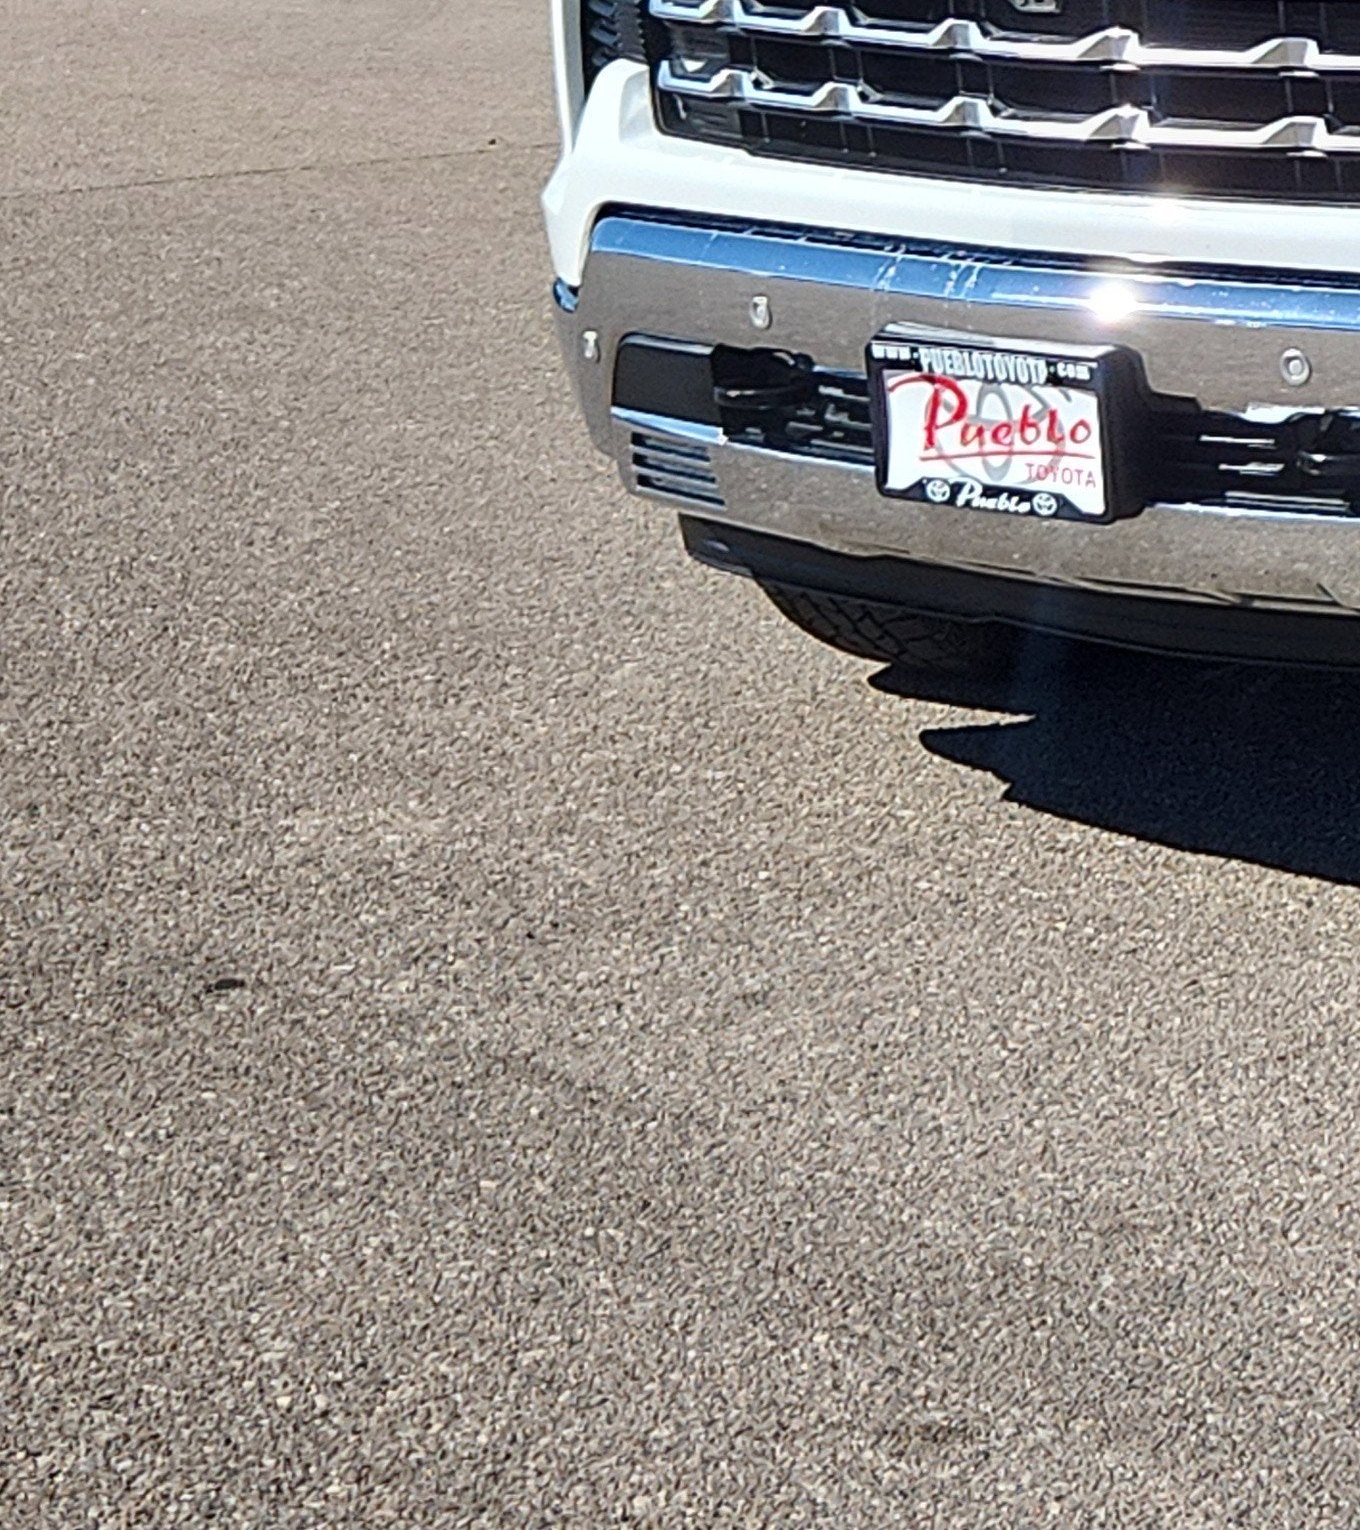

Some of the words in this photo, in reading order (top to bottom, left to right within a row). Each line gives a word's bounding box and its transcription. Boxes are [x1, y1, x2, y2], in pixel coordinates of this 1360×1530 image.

[888, 373, 1092, 451] Pueblo
[1025, 462, 1097, 488] TOYOTA
[951, 476, 1031, 513] Pueblo
